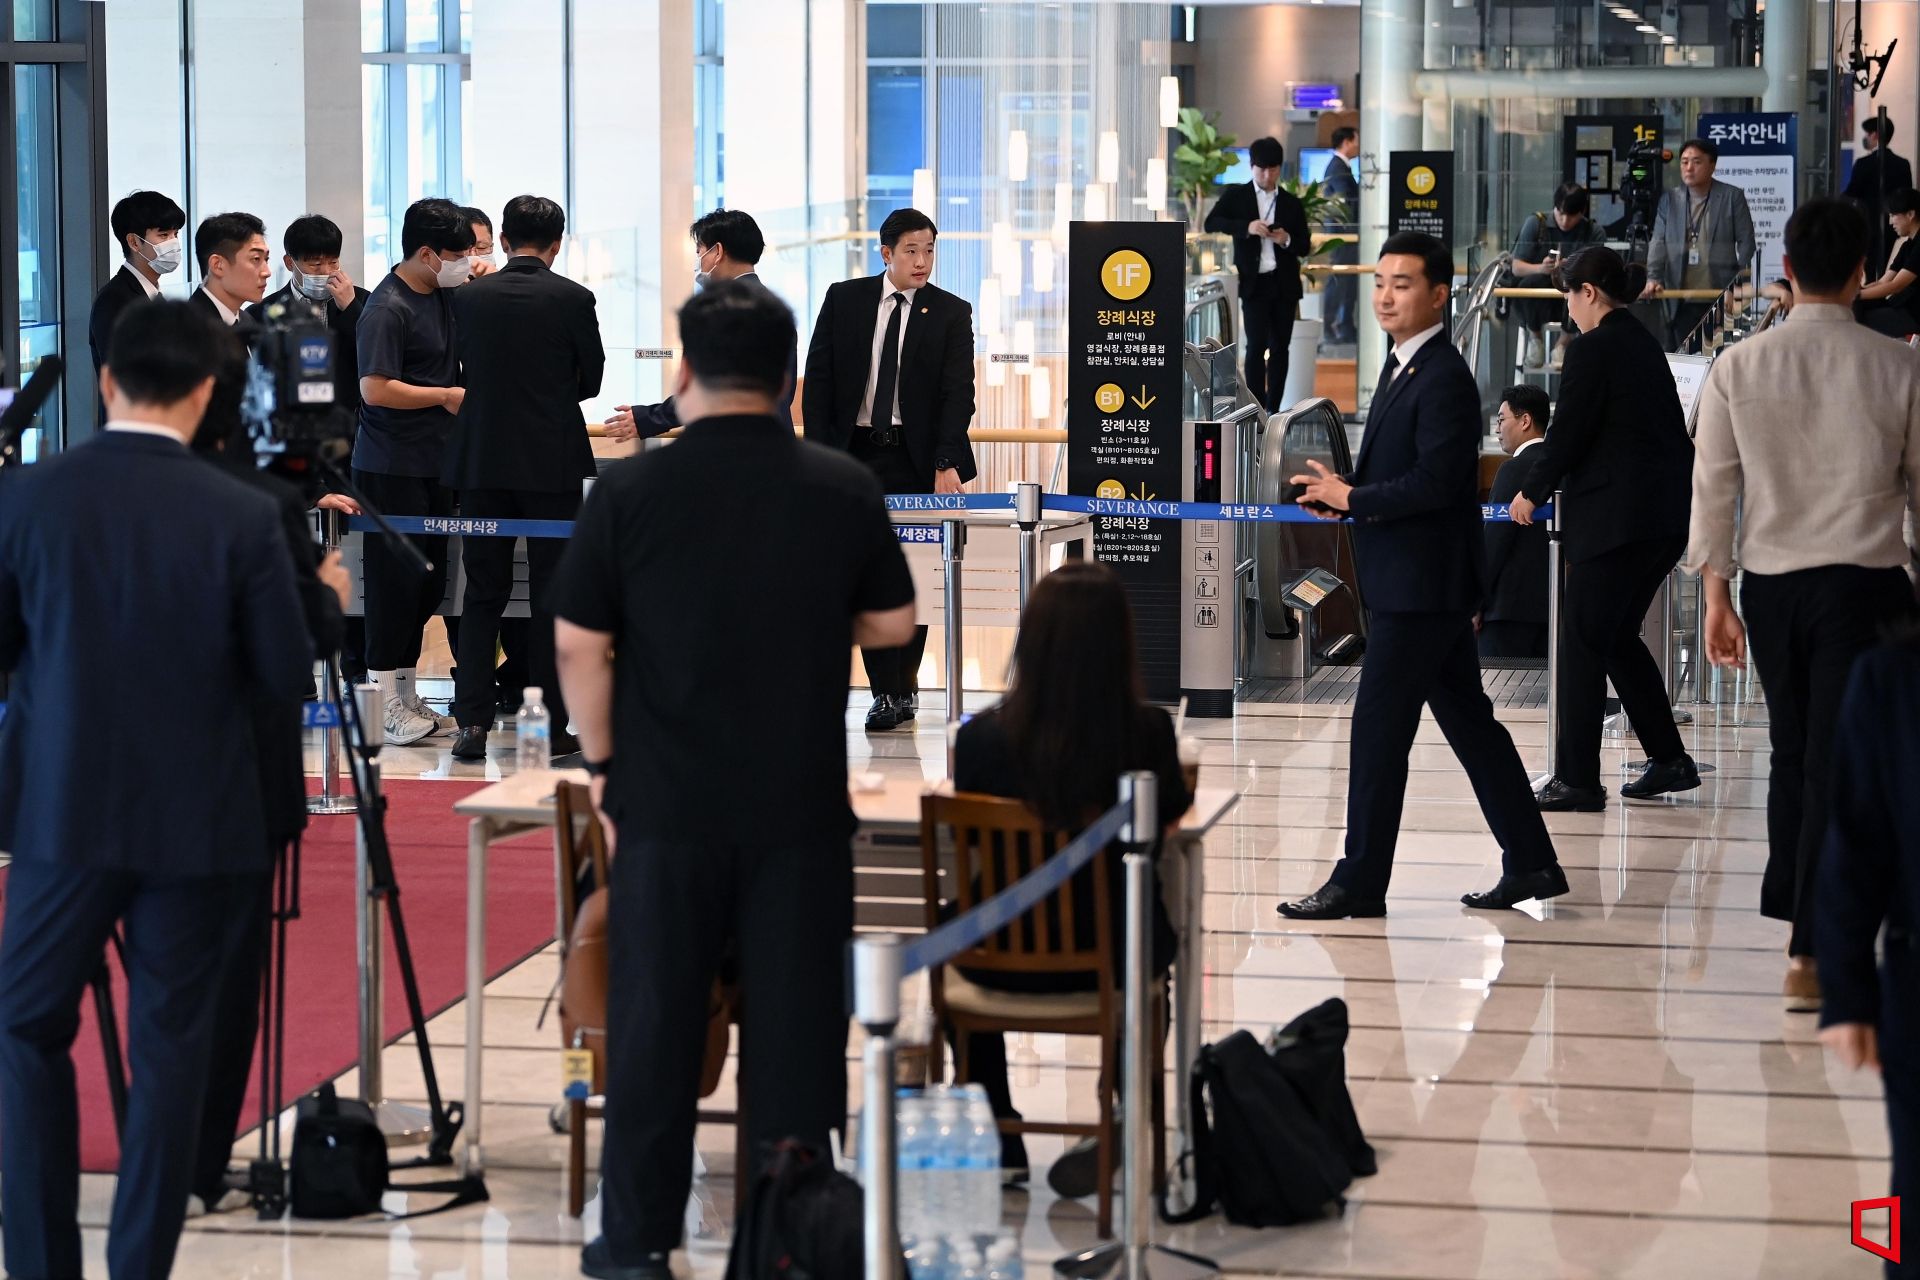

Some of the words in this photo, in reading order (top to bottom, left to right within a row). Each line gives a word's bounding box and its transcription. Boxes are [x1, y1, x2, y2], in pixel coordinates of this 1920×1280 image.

[1708, 122, 1786, 145] 주차안내
[1413, 173, 1430, 187] 1F
[1112, 263, 1142, 287] 1F
[1097, 310, 1156, 326] 장례식장
[1106, 332, 1122, 341] 로비
[1123, 332, 1146, 341] (안내)
[1086, 344, 1122, 353] 영결식장,
[1124, 344, 1165, 353] 장례용품점
[1114, 356, 1140, 366] 안치실,
[1141, 356, 1165, 366] 상담실
[1100, 391, 1120, 406] B1
[1101, 419, 1151, 432] 장례식장
[1101, 487, 1122, 499] B2
[884, 496, 967, 509] EVERANCE
[1086, 500, 1179, 516] SEVERANCE
[1219, 506, 1274, 518] 세브란스
[1481, 505, 1509, 519] 란스
[423, 519, 499, 534] 연세장례식장
[1100, 517, 1150, 530] 장례식장
[1104, 544, 1160, 552] (B201~B205호실)
[1098, 554, 1121, 562] 편의점,
